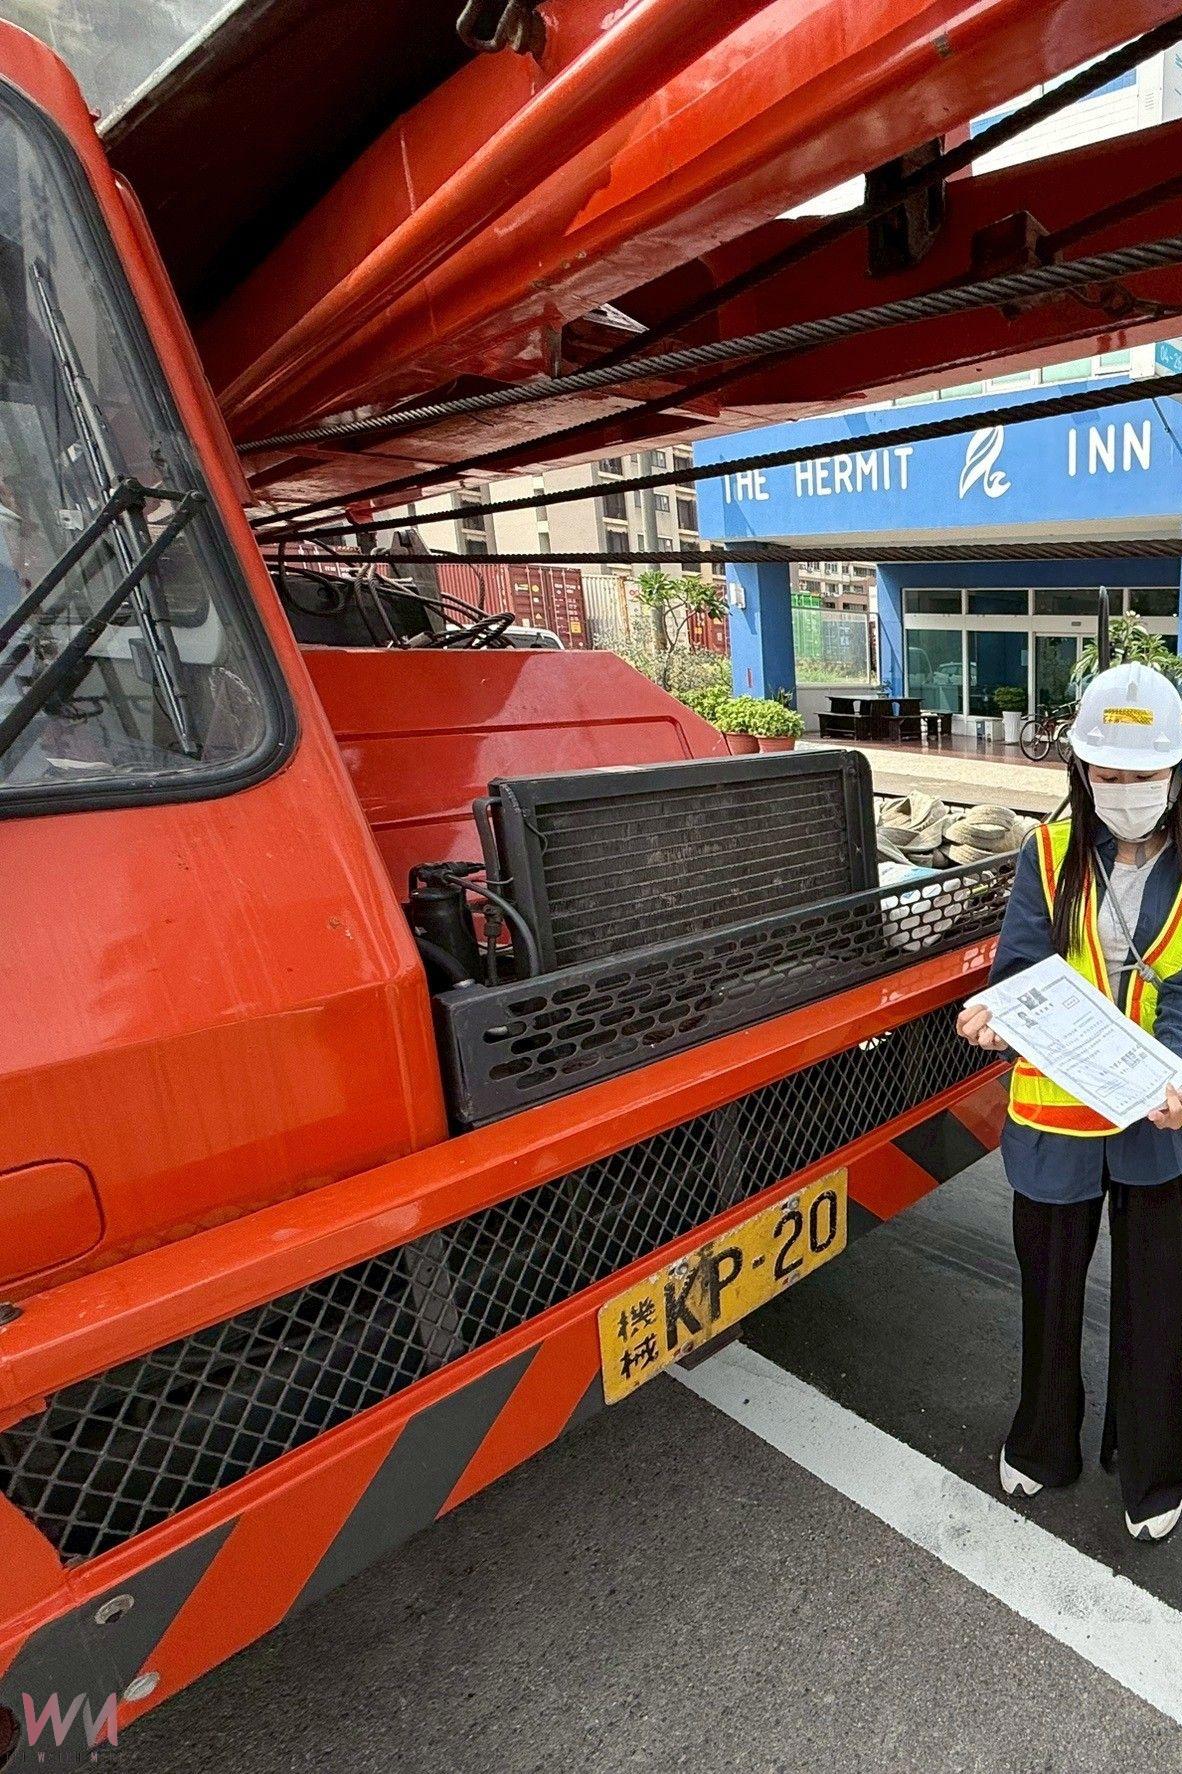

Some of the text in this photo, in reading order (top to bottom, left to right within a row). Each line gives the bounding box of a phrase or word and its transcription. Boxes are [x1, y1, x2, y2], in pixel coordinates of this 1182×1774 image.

[723, 419, 1152, 503] THE HERMIT INN
[664, 1189, 838, 1353] KP-20
